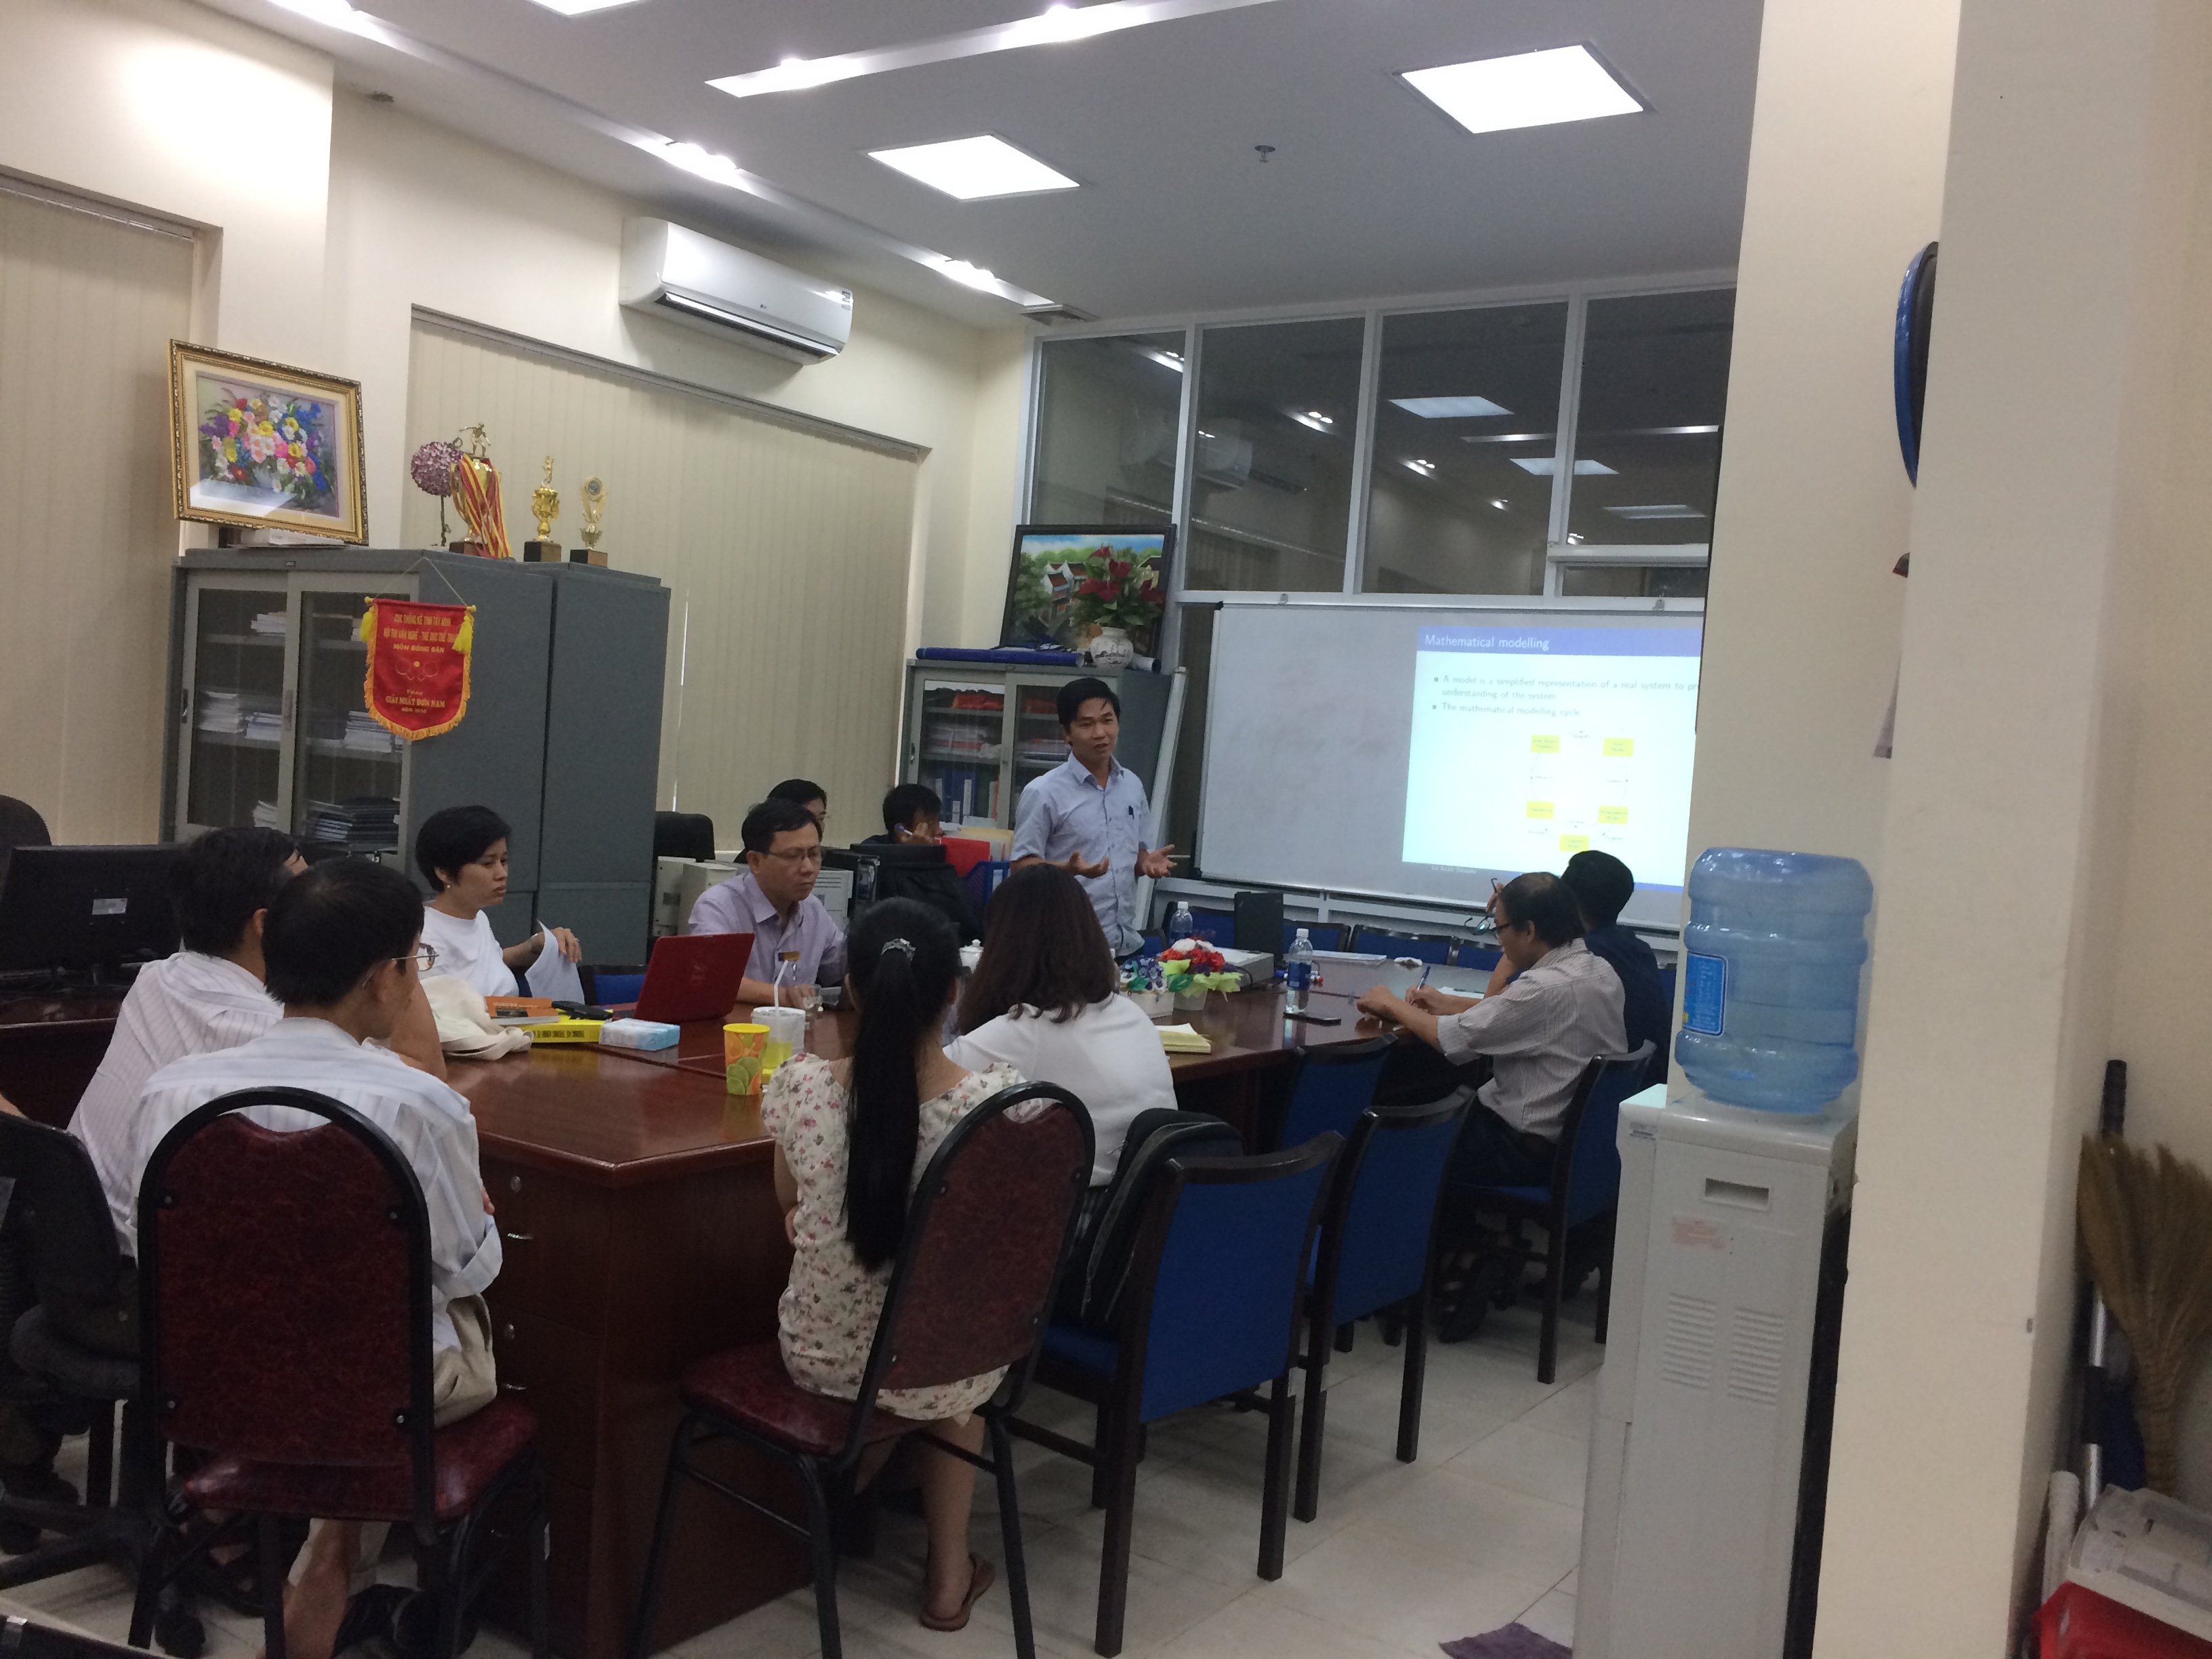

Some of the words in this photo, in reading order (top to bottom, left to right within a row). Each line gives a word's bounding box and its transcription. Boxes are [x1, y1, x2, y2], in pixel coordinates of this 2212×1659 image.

[1425, 634, 1494, 647] Mathematical
[1498, 636, 1550, 651] modelling
[1442, 674, 1450, 683] A
[1496, 678, 1535, 687] simplified
[1538, 680, 1597, 689] representation
[1601, 680, 1610, 689] of
[1641, 682, 1671, 691] system
[1442, 689, 1498, 700] understanding
[1528, 693, 1556, 701] system
[1442, 702, 1457, 711] The
[1460, 704, 1513, 714] mathematical
[1517, 707, 1556, 716] modelling
[1560, 708, 1580, 717] cycle
